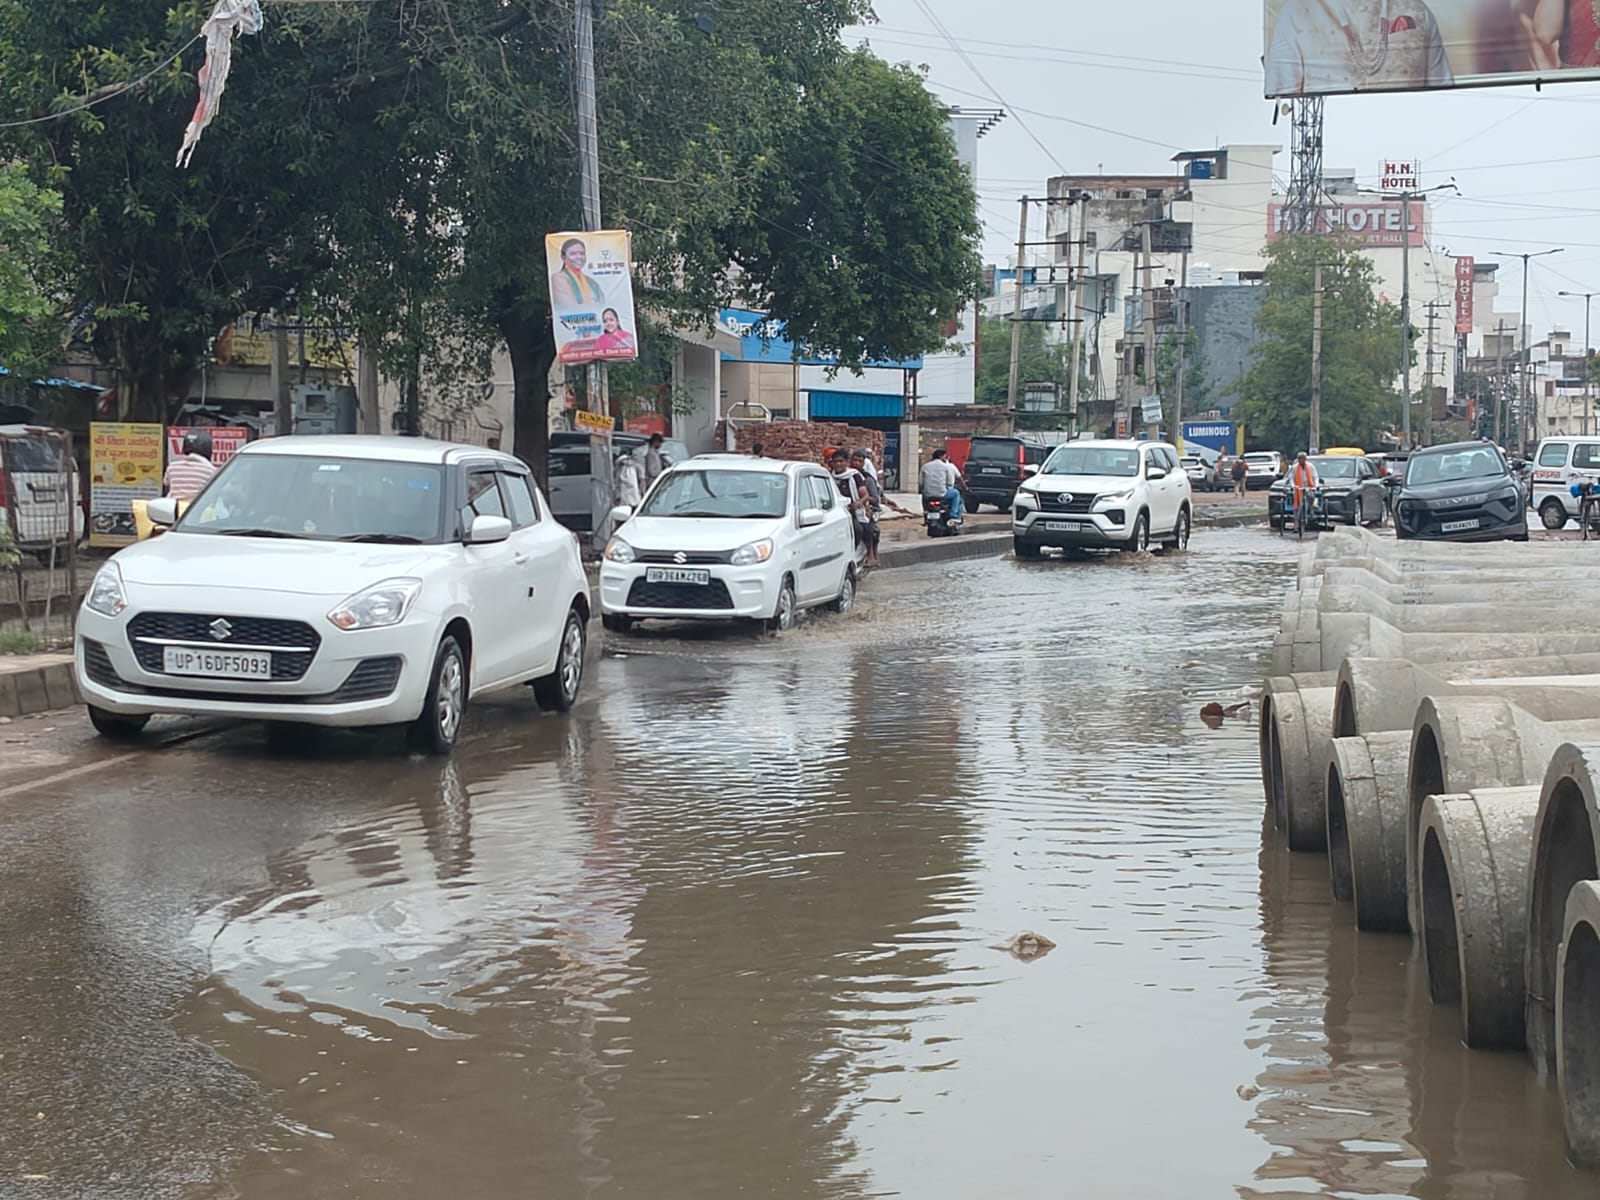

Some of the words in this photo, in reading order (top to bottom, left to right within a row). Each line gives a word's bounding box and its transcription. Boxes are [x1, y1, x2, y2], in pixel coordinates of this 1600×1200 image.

[1385, 163, 1414, 175] H.N.
[1381, 178, 1418, 189] HOTEL
[1326, 207, 1417, 233] HOTEL
[1188, 426, 1231, 438] LUMINOUS
[174, 652, 269, 674] UP16DF5093
